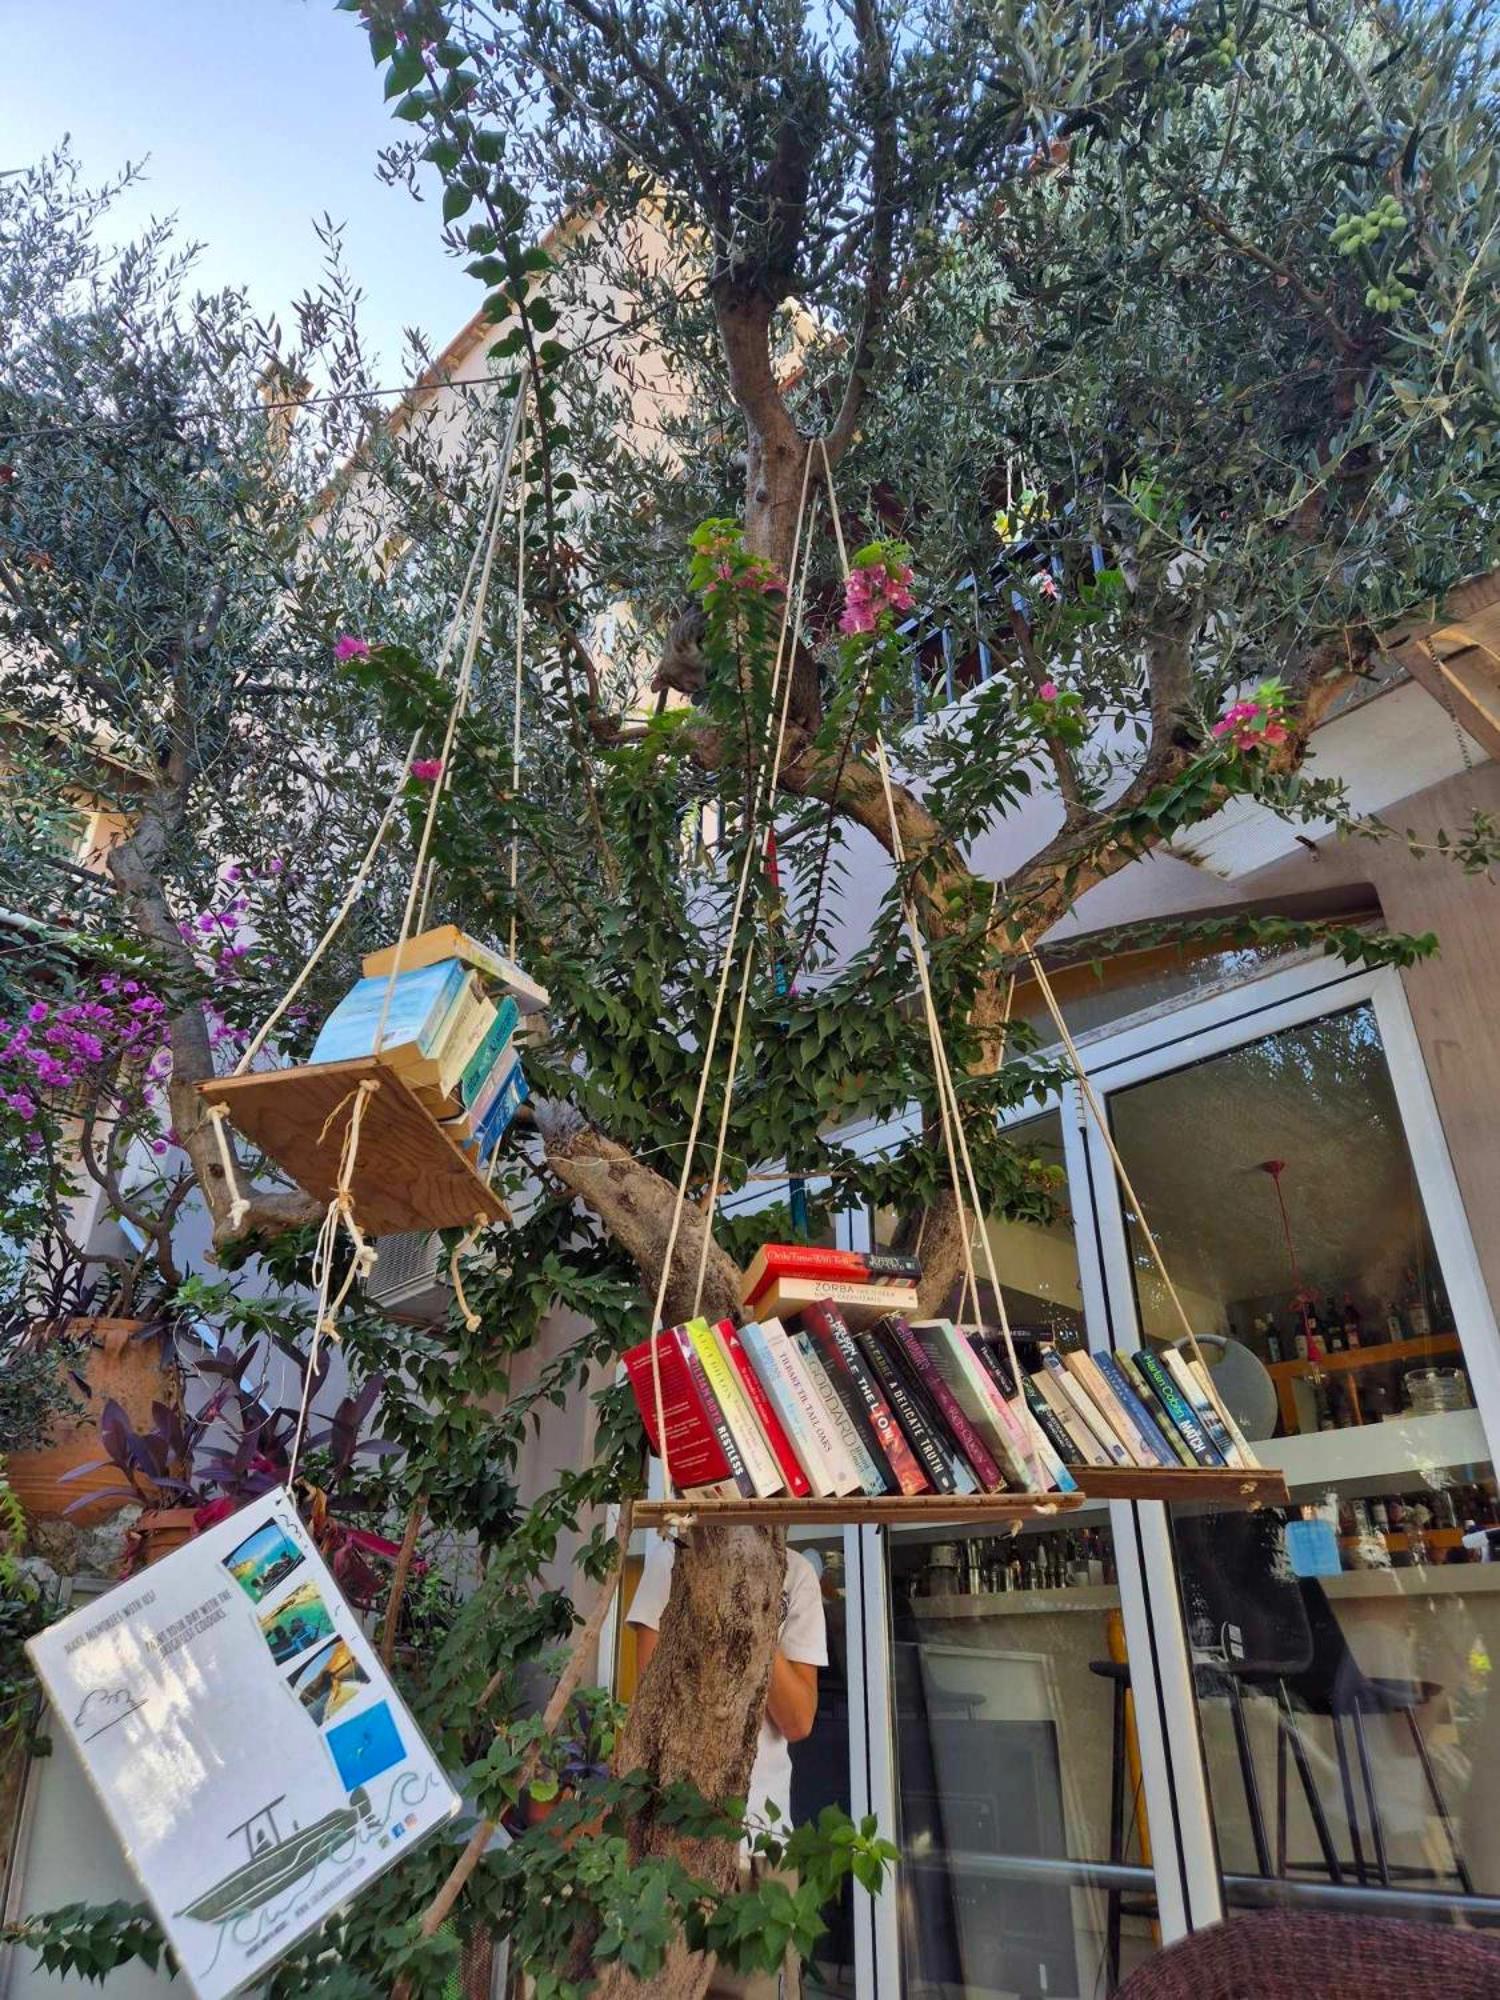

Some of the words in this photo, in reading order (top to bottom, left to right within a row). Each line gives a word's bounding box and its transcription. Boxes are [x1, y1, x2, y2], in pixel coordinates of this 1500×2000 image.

[815, 1282, 855, 1294] ZORBA
[832, 1319, 858, 1357] NELSON
[821, 1311, 860, 1375] DEMILLE
[856, 1376, 876, 1404] THE
[868, 1401, 895, 1440] LION
[888, 1379, 899, 1390] A
[1142, 1353, 1168, 1386] Harlan
[1159, 1383, 1187, 1418] Coben
[778, 1352, 801, 1388] TILBAKE
[796, 1389, 809, 1406] TIL
[803, 1403, 821, 1429] TALL
[815, 1426, 833, 1453] OAKS
[803, 1359, 860, 1448] GODDARD
[891, 1388, 925, 1437] DELICATE
[715, 1424, 745, 1476] RESTLESS
[918, 1438, 944, 1474] TRUTH
[1177, 1417, 1207, 1453] MATCH
[200, 1598, 220, 1616] WITH
[218, 1589, 232, 1604] THE
